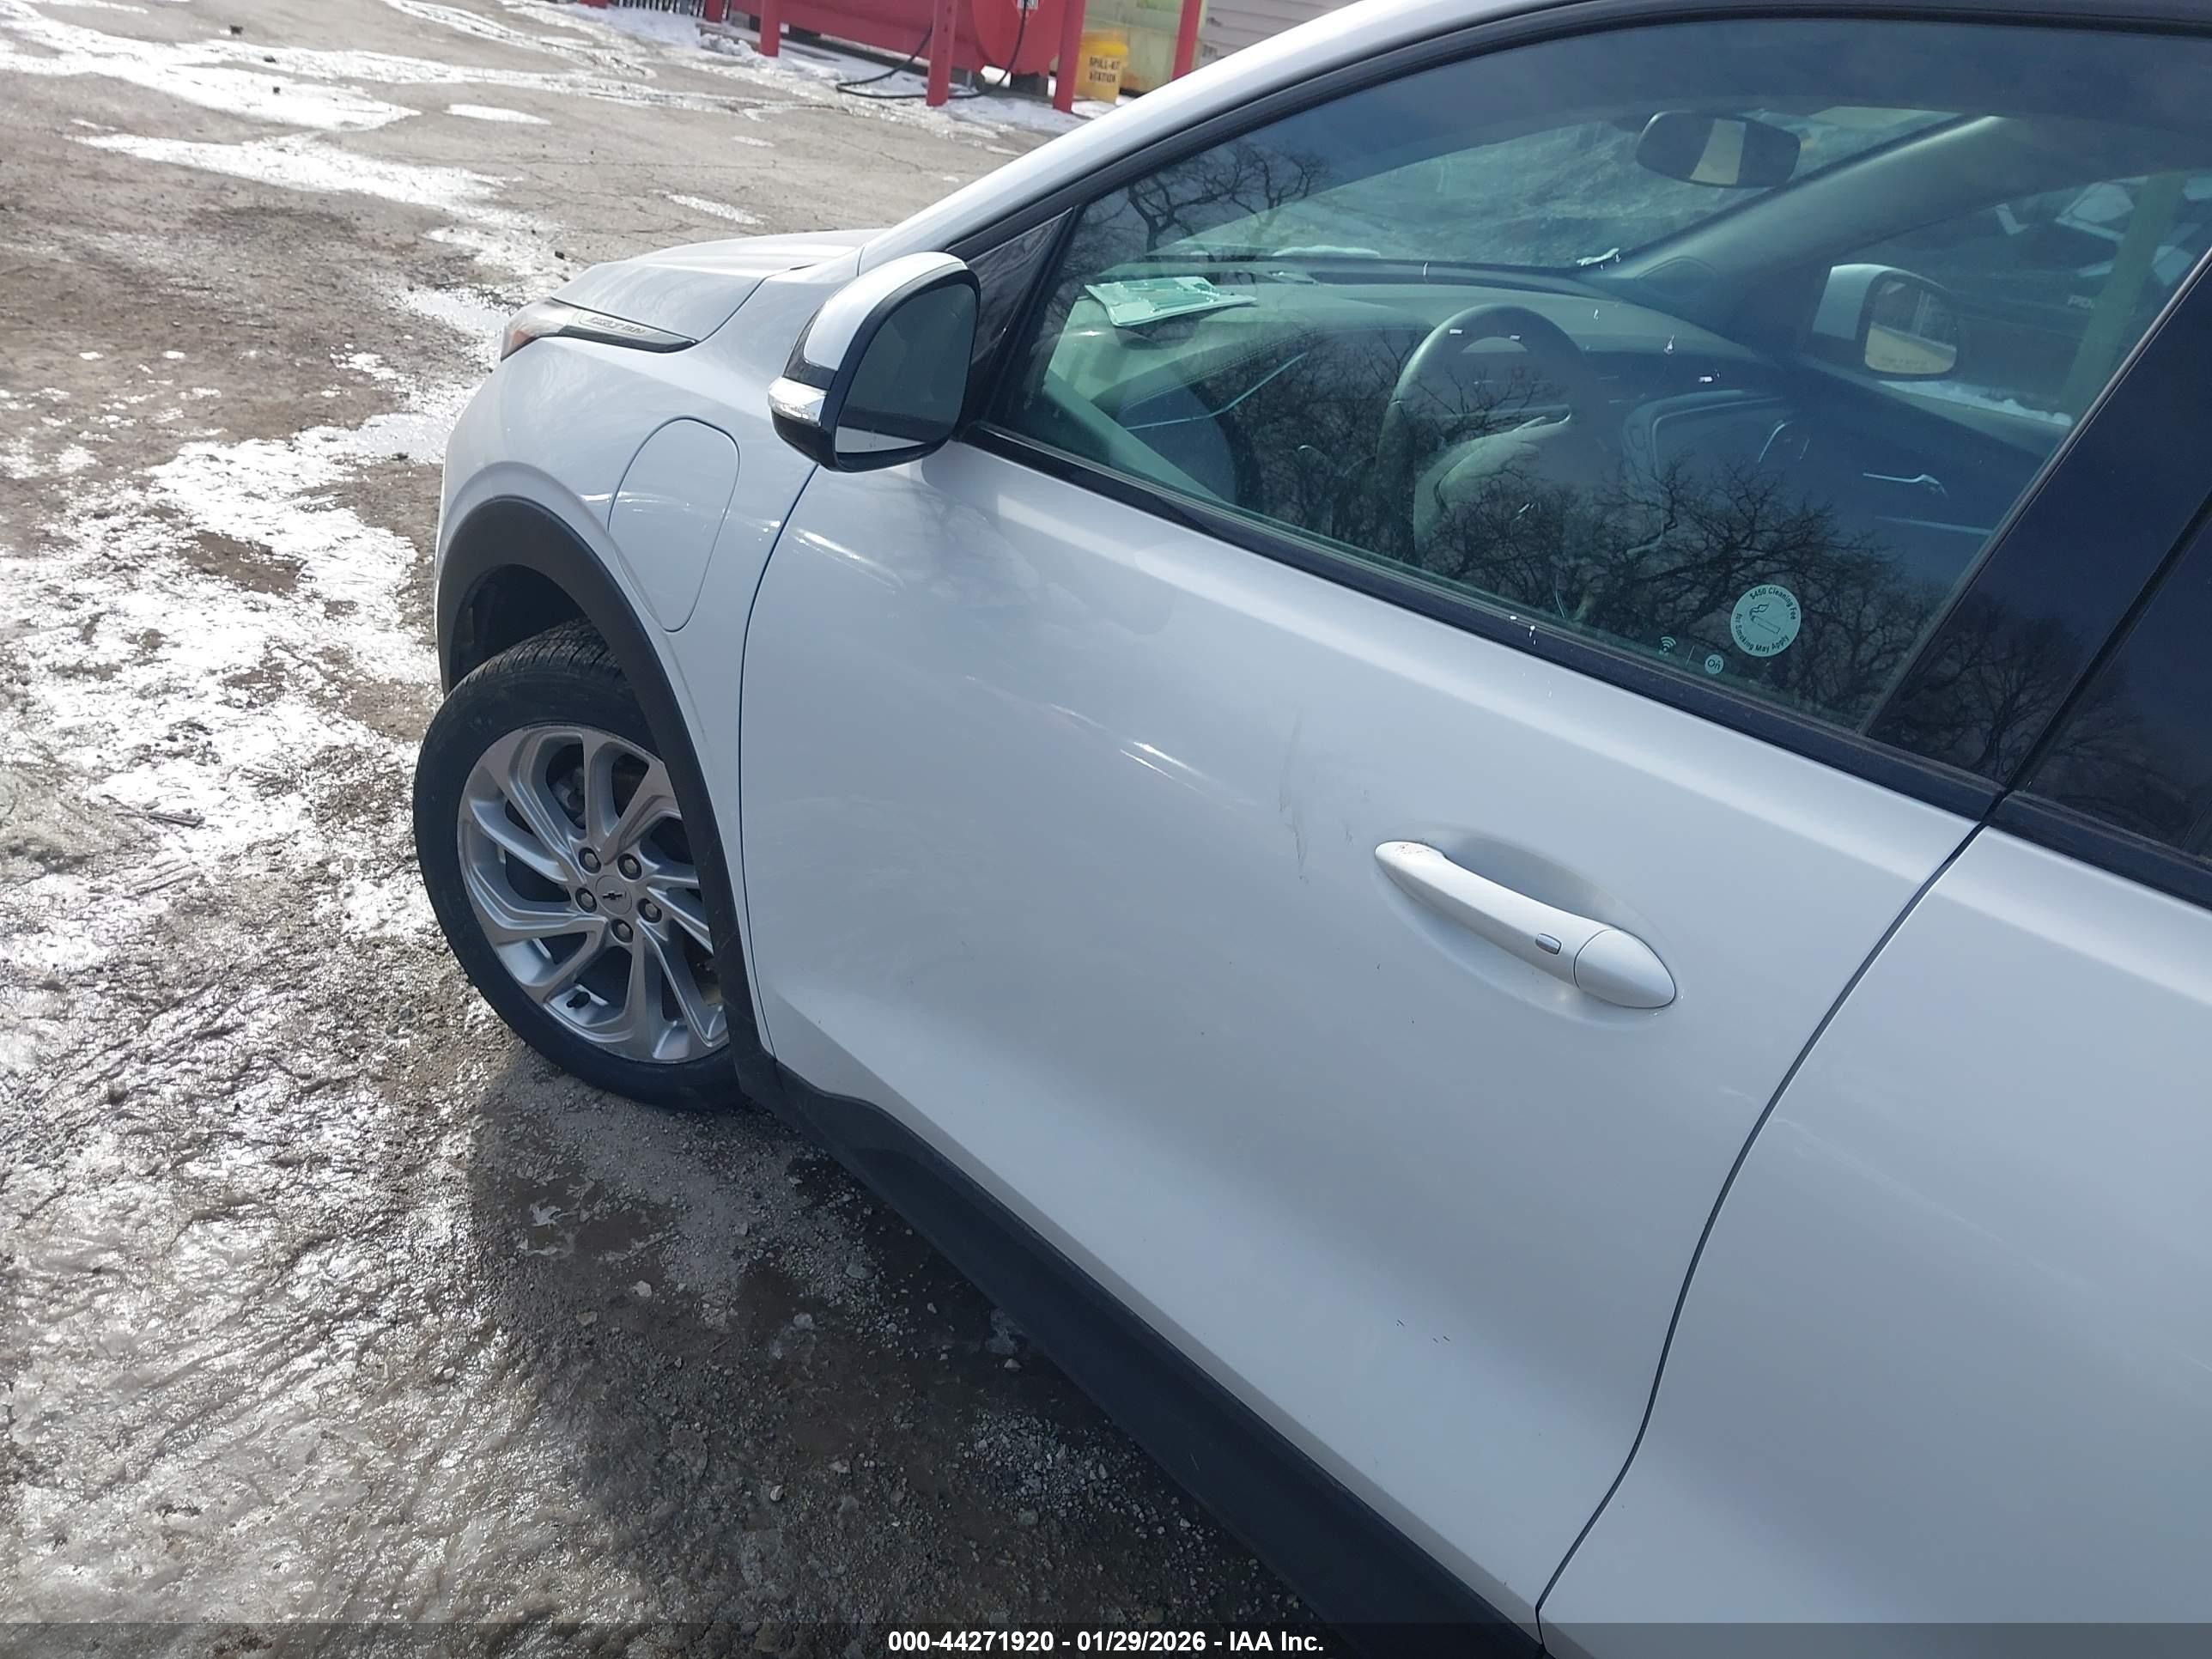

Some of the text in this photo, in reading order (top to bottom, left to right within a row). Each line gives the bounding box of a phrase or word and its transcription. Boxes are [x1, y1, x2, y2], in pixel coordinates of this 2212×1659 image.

[1749, 586, 1797, 620] $450 Cleaning Fee
[1735, 612, 1790, 653] for Smoking May Apply
